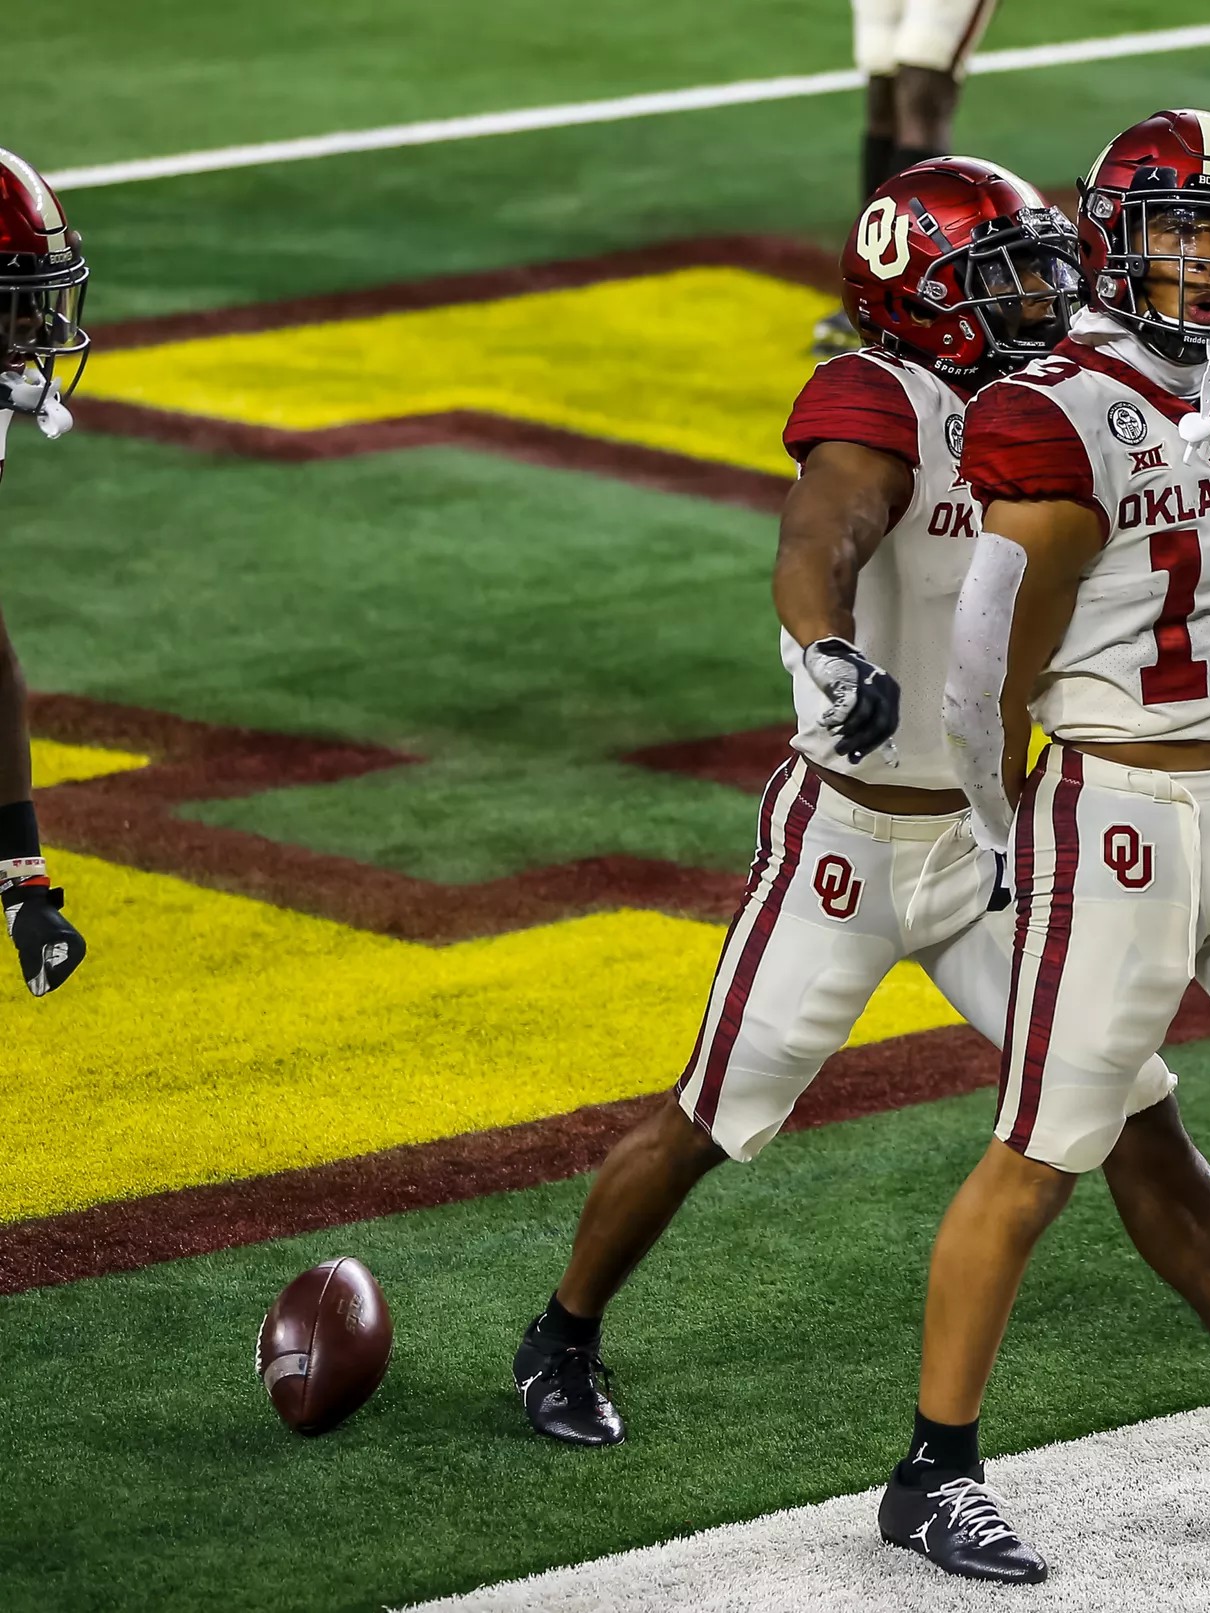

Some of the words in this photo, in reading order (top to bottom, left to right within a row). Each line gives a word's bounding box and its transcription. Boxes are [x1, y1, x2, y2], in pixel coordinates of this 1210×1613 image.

[857, 196, 911, 281] OU
[1183, 335, 1206, 344] Ridde
[1128, 443, 1169, 475] XII
[811, 851, 866, 922] OU
[1101, 822, 1156, 892] OU
